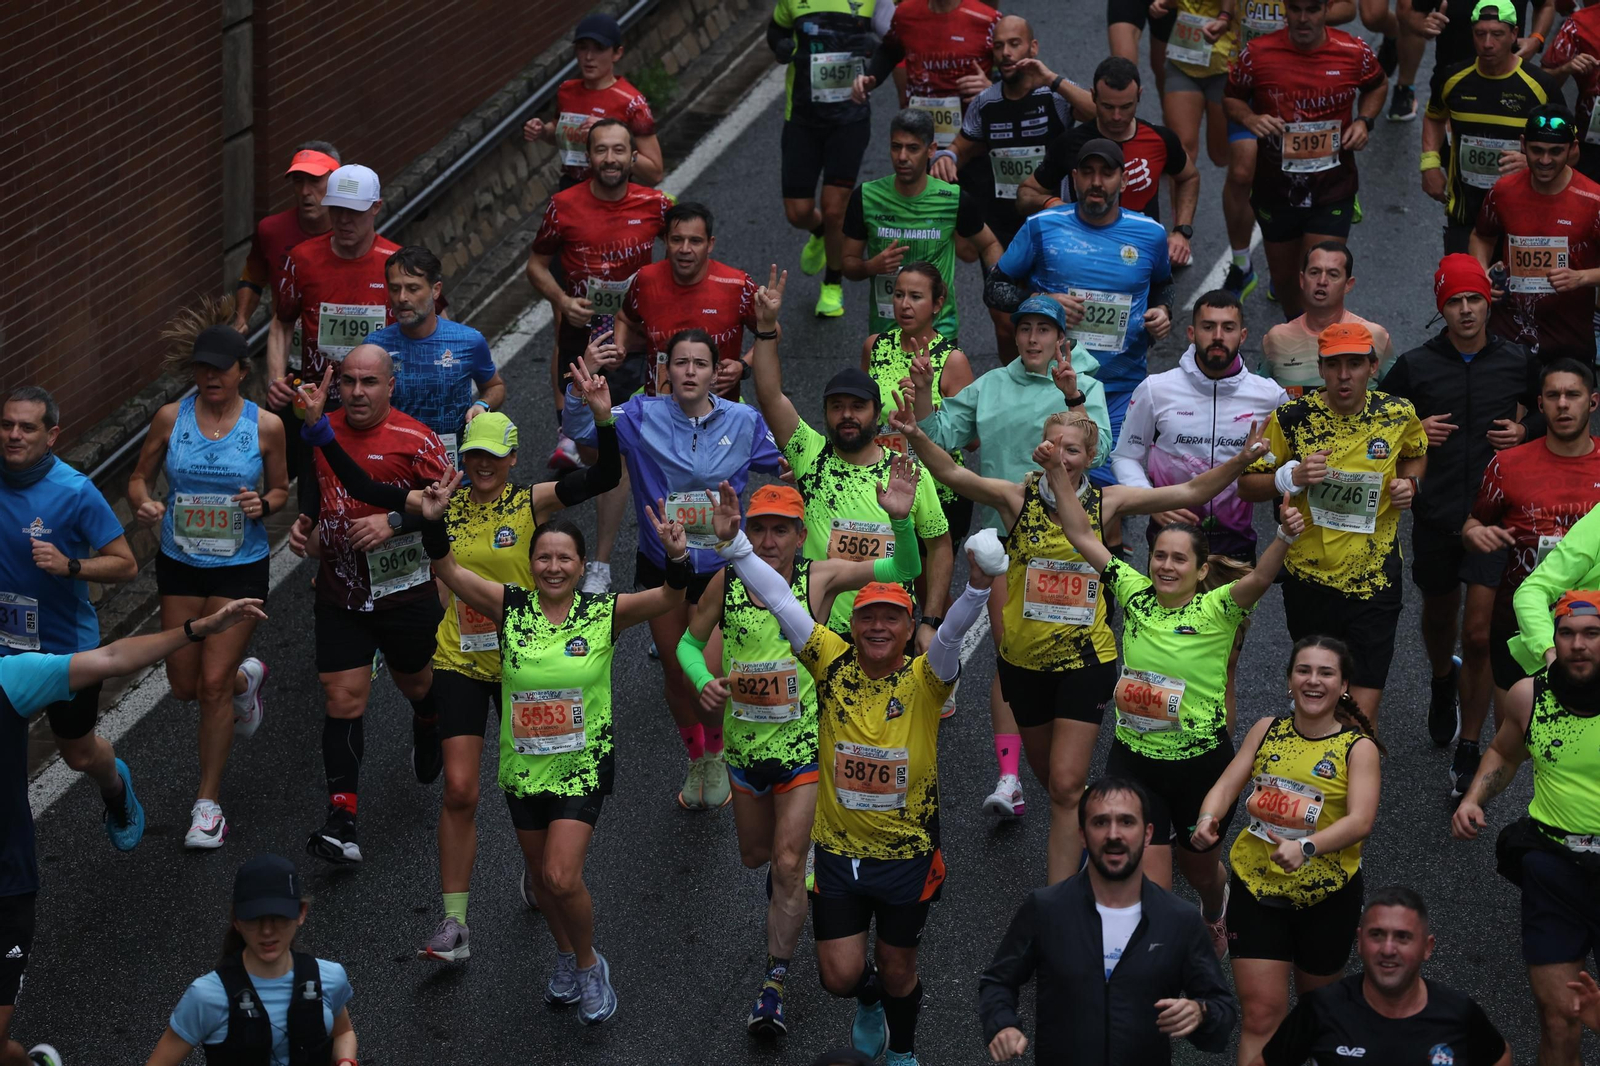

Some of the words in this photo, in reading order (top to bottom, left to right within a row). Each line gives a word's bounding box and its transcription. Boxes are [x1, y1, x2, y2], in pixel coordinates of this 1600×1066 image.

[1246, 1, 1283, 20] CALL
[819, 65, 852, 81] 9457
[1292, 133, 1328, 152] 5197
[1000, 160, 1033, 176] 6805
[877, 227, 902, 239] MEDIO
[904, 227, 941, 240] MARATÓN
[1516, 250, 1552, 268] 5052
[594, 292, 621, 308] 931
[1086, 306, 1116, 325] 322
[328, 319, 370, 337] 7199
[1173, 433, 1203, 445] SIERRA
[1215, 436, 1246, 447] SEGURA
[188, 470, 242, 478] EXTREMADURA
[1320, 482, 1363, 505] 7746
[184, 509, 229, 528] 7313
[837, 535, 880, 557] 5562
[379, 548, 417, 573] 9610
[1037, 573, 1082, 596] 5219
[0, 607, 18, 625] 31
[737, 676, 780, 696] 5221
[1123, 683, 1163, 708] 5604
[521, 704, 566, 727] 5553
[844, 759, 890, 783] 5876
[1257, 791, 1301, 818] 6061
[1336, 1045, 1366, 1058] EV2
